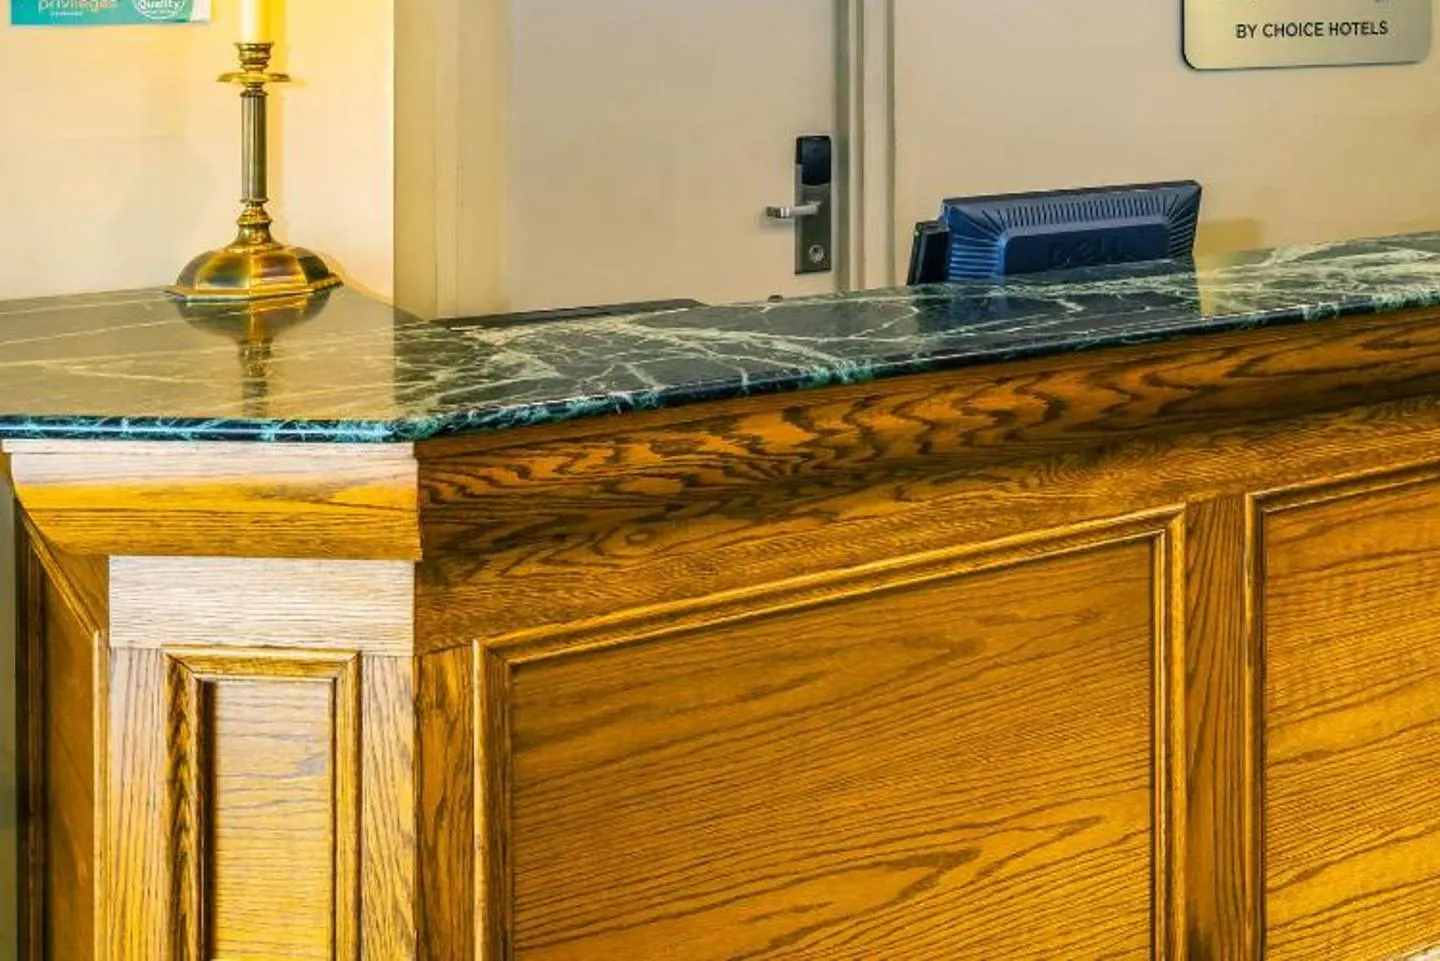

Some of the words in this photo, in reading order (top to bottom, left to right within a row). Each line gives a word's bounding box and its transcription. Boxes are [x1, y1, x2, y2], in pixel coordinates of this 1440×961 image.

[1236, 23, 1258, 39] BY
[1262, 20, 1325, 38] CHOICE
[1328, 20, 1389, 37] HOTELS
